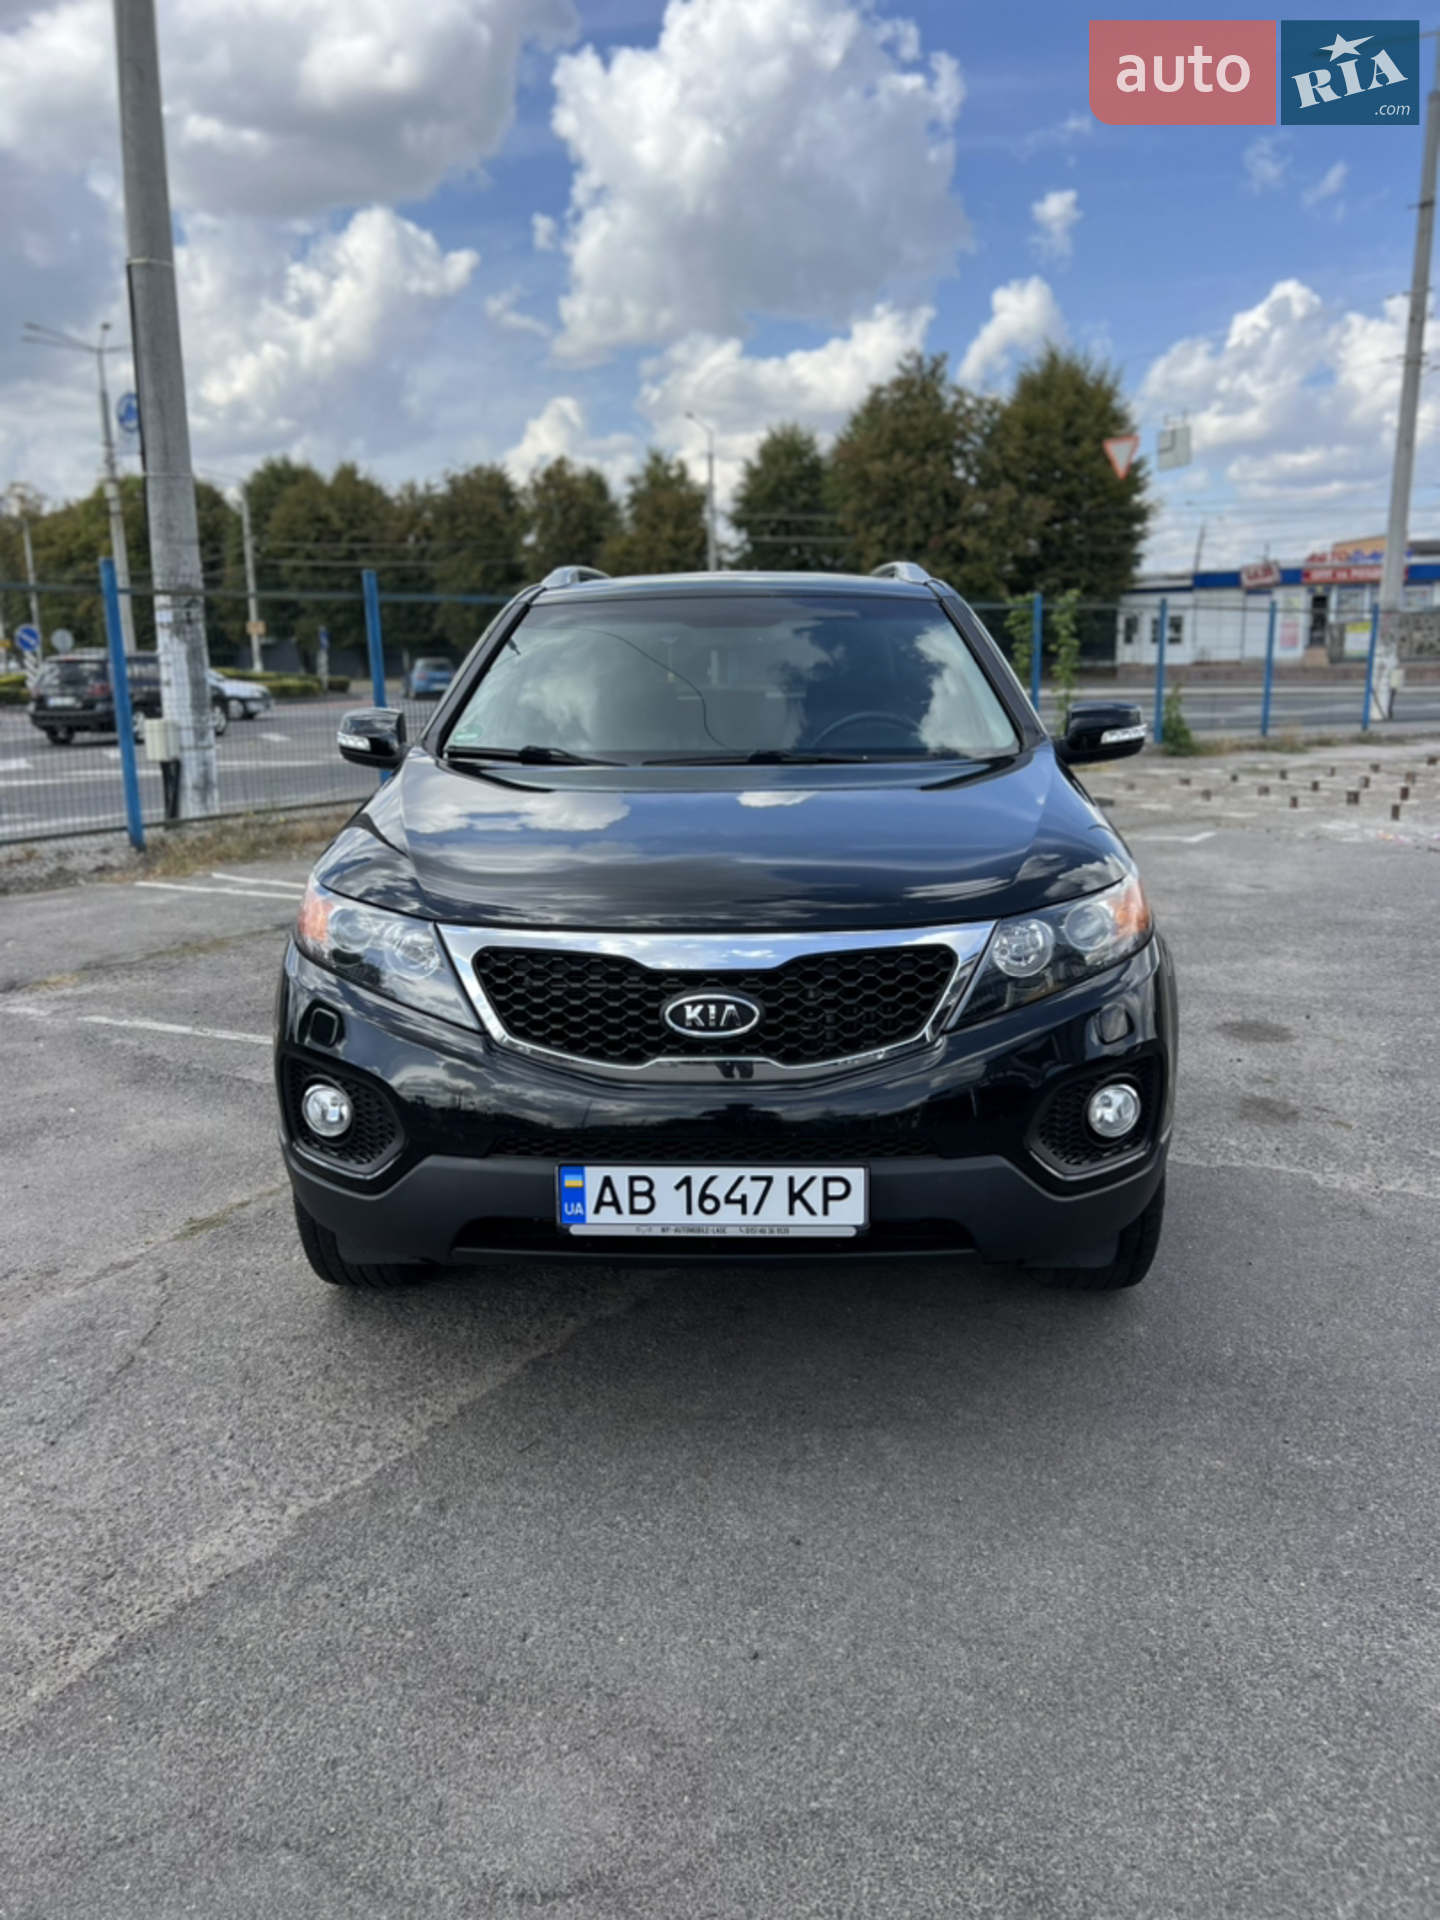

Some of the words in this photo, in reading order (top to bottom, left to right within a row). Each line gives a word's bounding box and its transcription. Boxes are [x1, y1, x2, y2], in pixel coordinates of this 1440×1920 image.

[684, 1004, 741, 1027] KIA
[593, 1175, 657, 1216] AB
[673, 1175, 773, 1216] 1647
[787, 1175, 852, 1217] KP
[564, 1202, 585, 1216] UA
